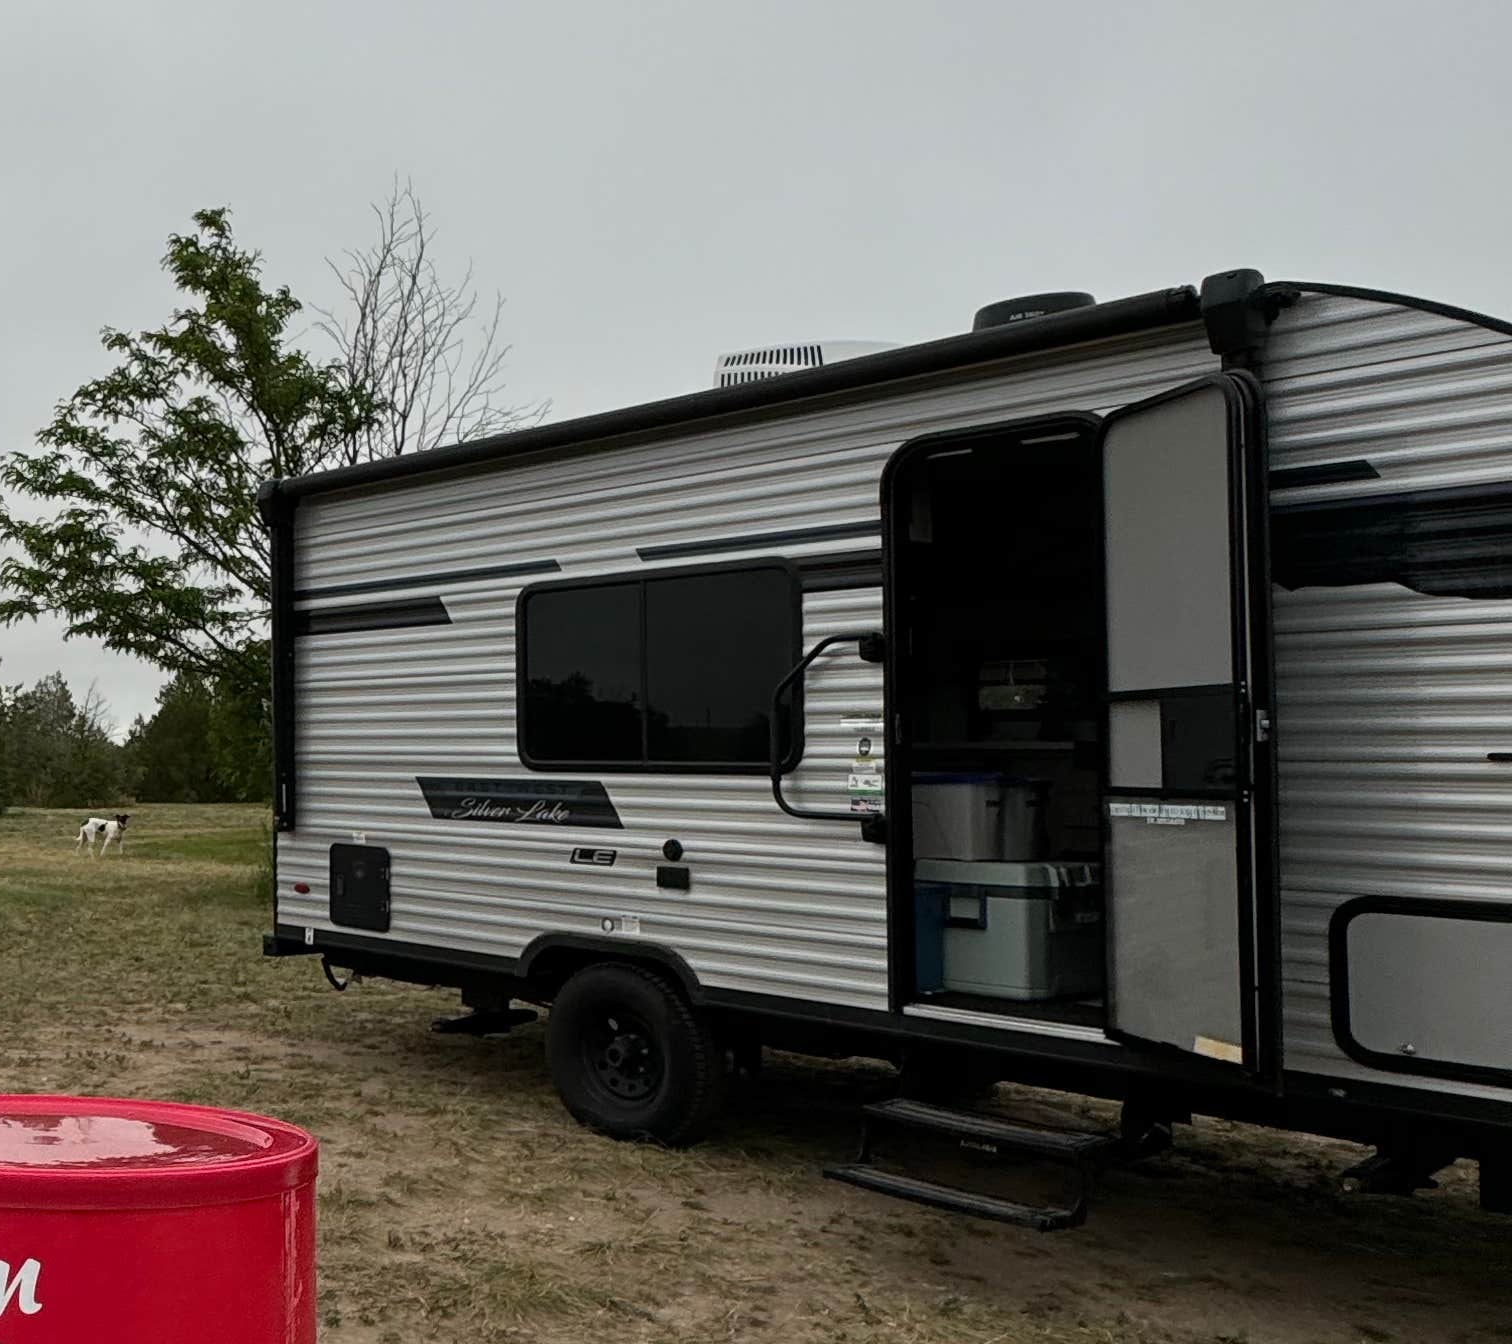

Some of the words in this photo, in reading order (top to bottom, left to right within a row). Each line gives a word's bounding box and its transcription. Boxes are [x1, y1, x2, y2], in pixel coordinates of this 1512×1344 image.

[452, 797, 511, 819] Silver
[515, 799, 569, 823] Lake
[574, 850, 614, 864] LE
